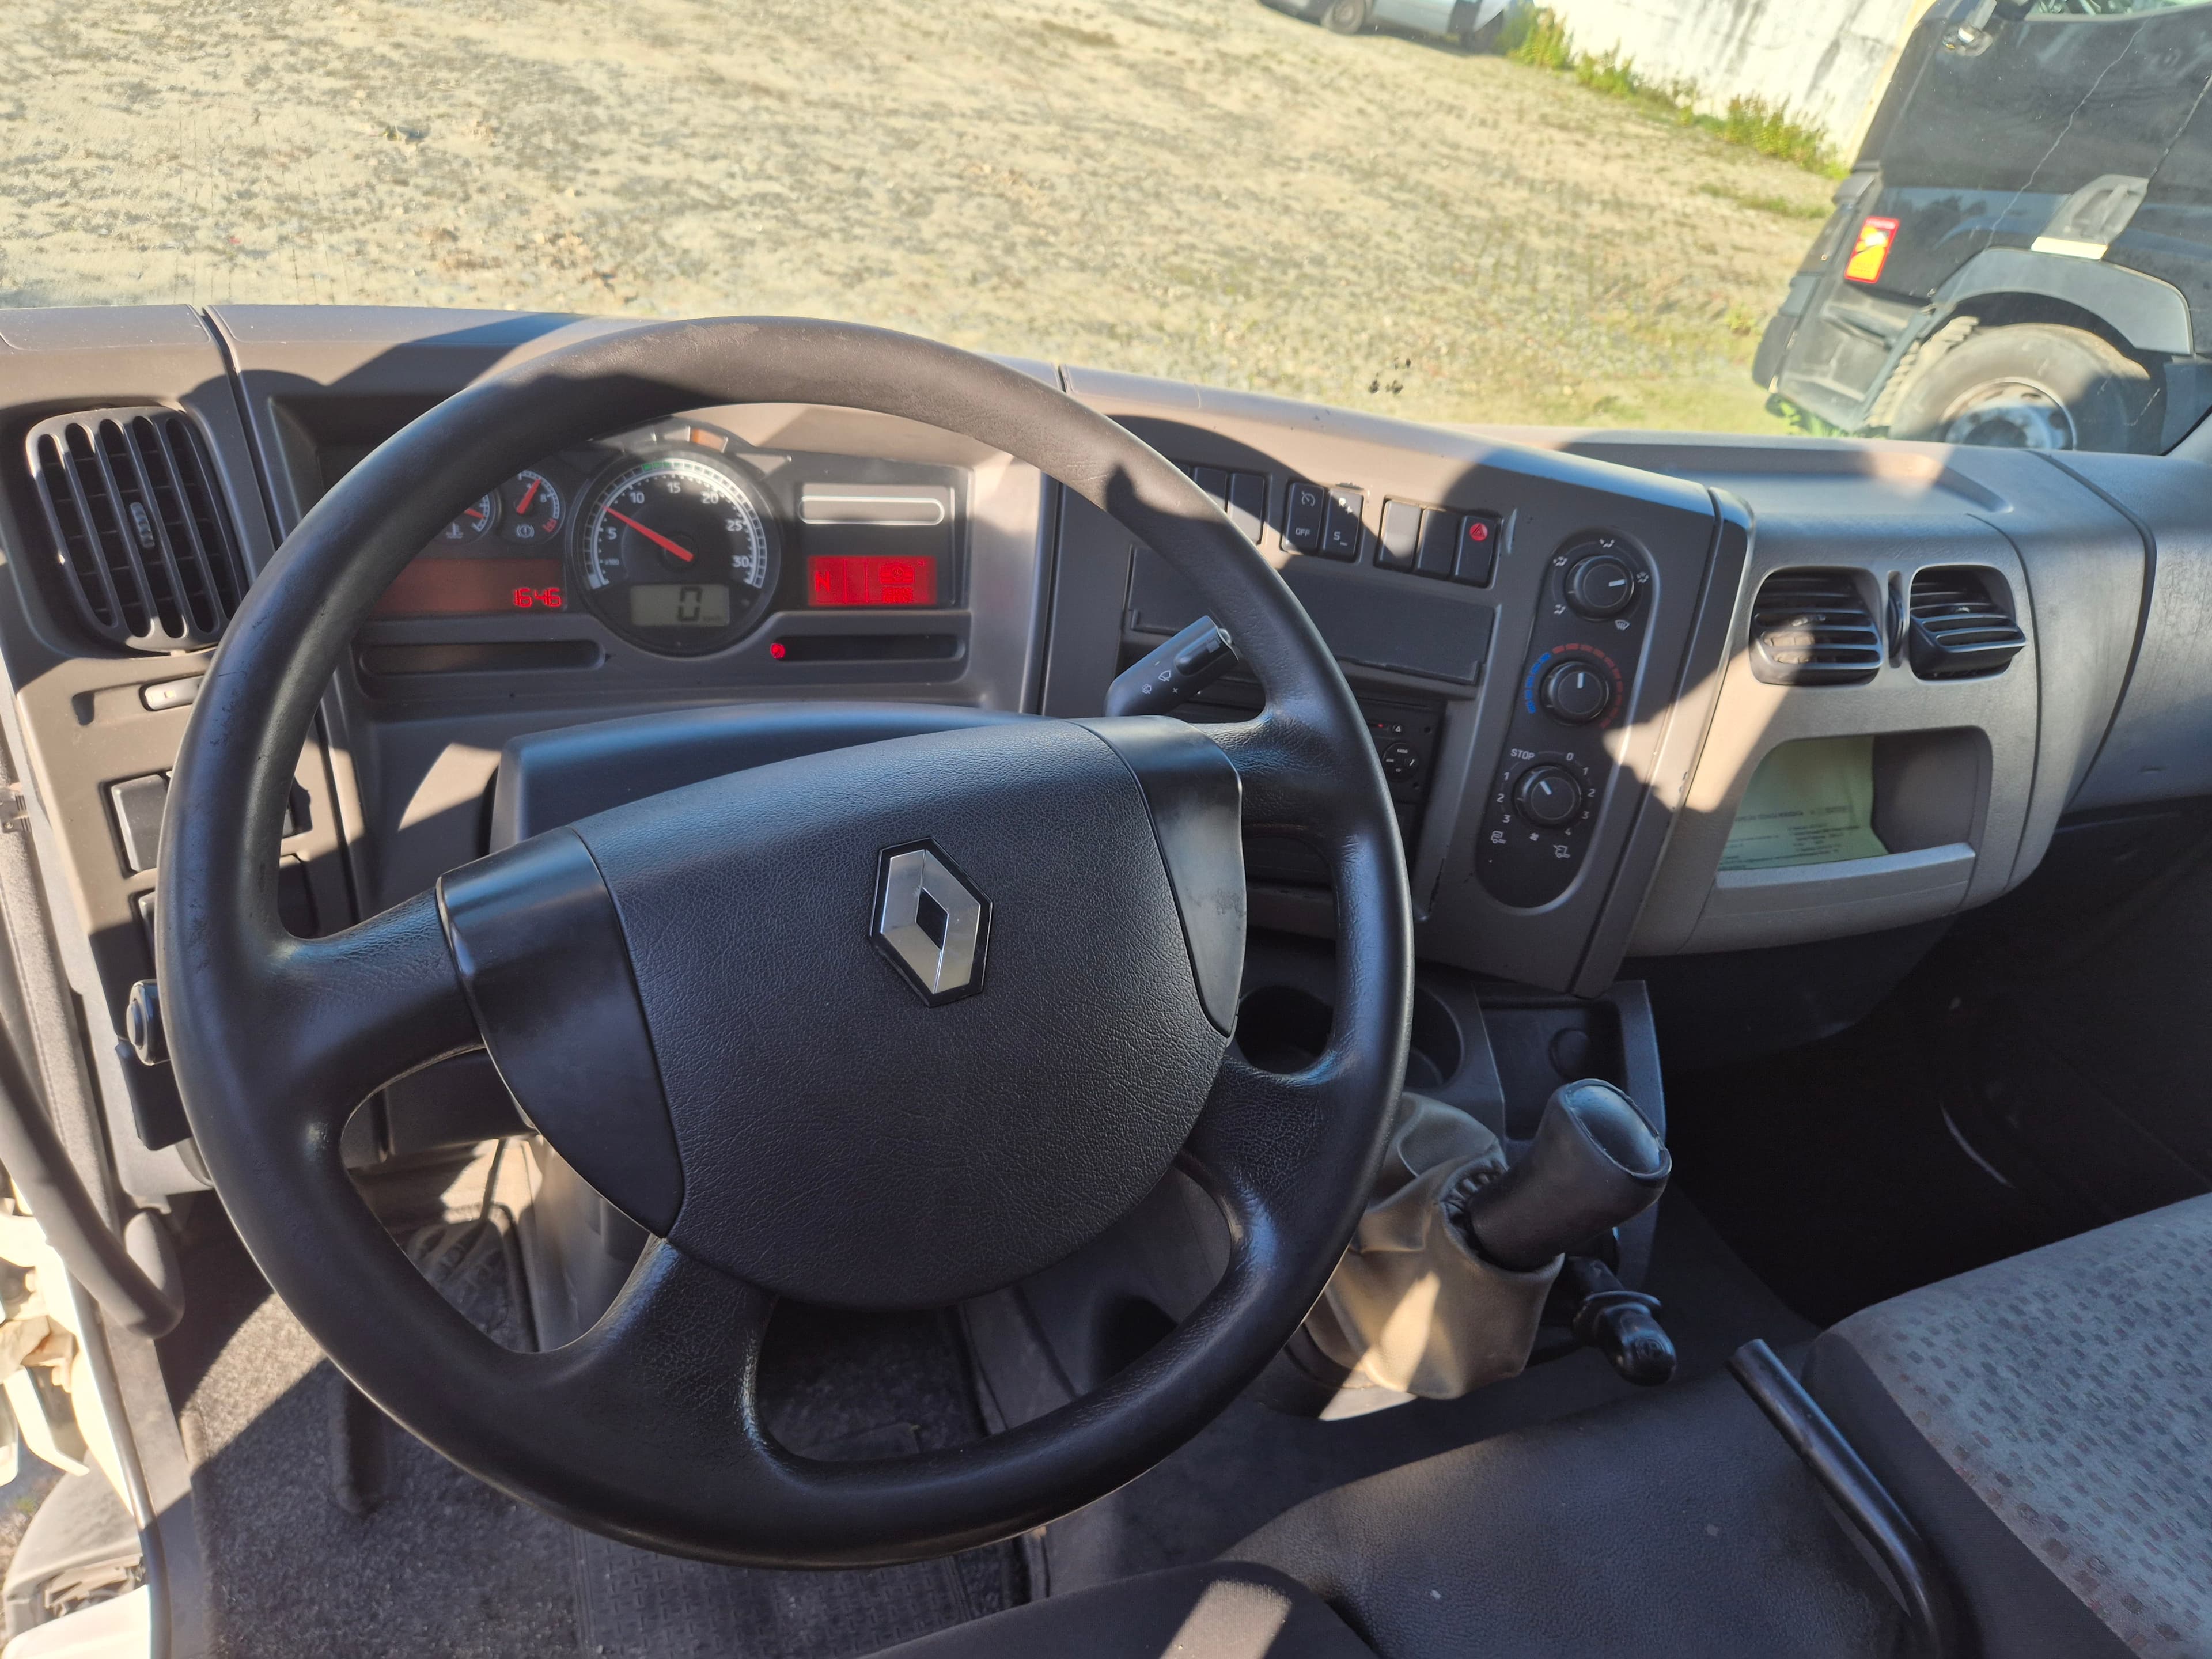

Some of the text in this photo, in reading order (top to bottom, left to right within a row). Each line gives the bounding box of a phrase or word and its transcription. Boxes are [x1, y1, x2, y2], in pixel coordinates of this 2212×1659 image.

[667, 482, 681, 494] 15
[630, 492, 645, 503] 10
[701, 493, 718, 504] 20
[726, 520, 743, 531] 25
[607, 527, 617, 540] 5
[1295, 528, 1310, 536] OFF
[732, 555, 749, 567] 30
[815, 571, 830, 592] N
[677, 586, 702, 622] 0
[1510, 748, 1535, 760] STOP
[1566, 752, 1574, 761] 0
[1583, 767, 1589, 775] 1
[1504, 772, 1510, 781] 1
[1497, 793, 1505, 803] 2
[1588, 789, 1596, 797] 2
[1502, 815, 1510, 823] 3
[1582, 810, 1590, 819] 3
[1565, 828, 1571, 836] 4
